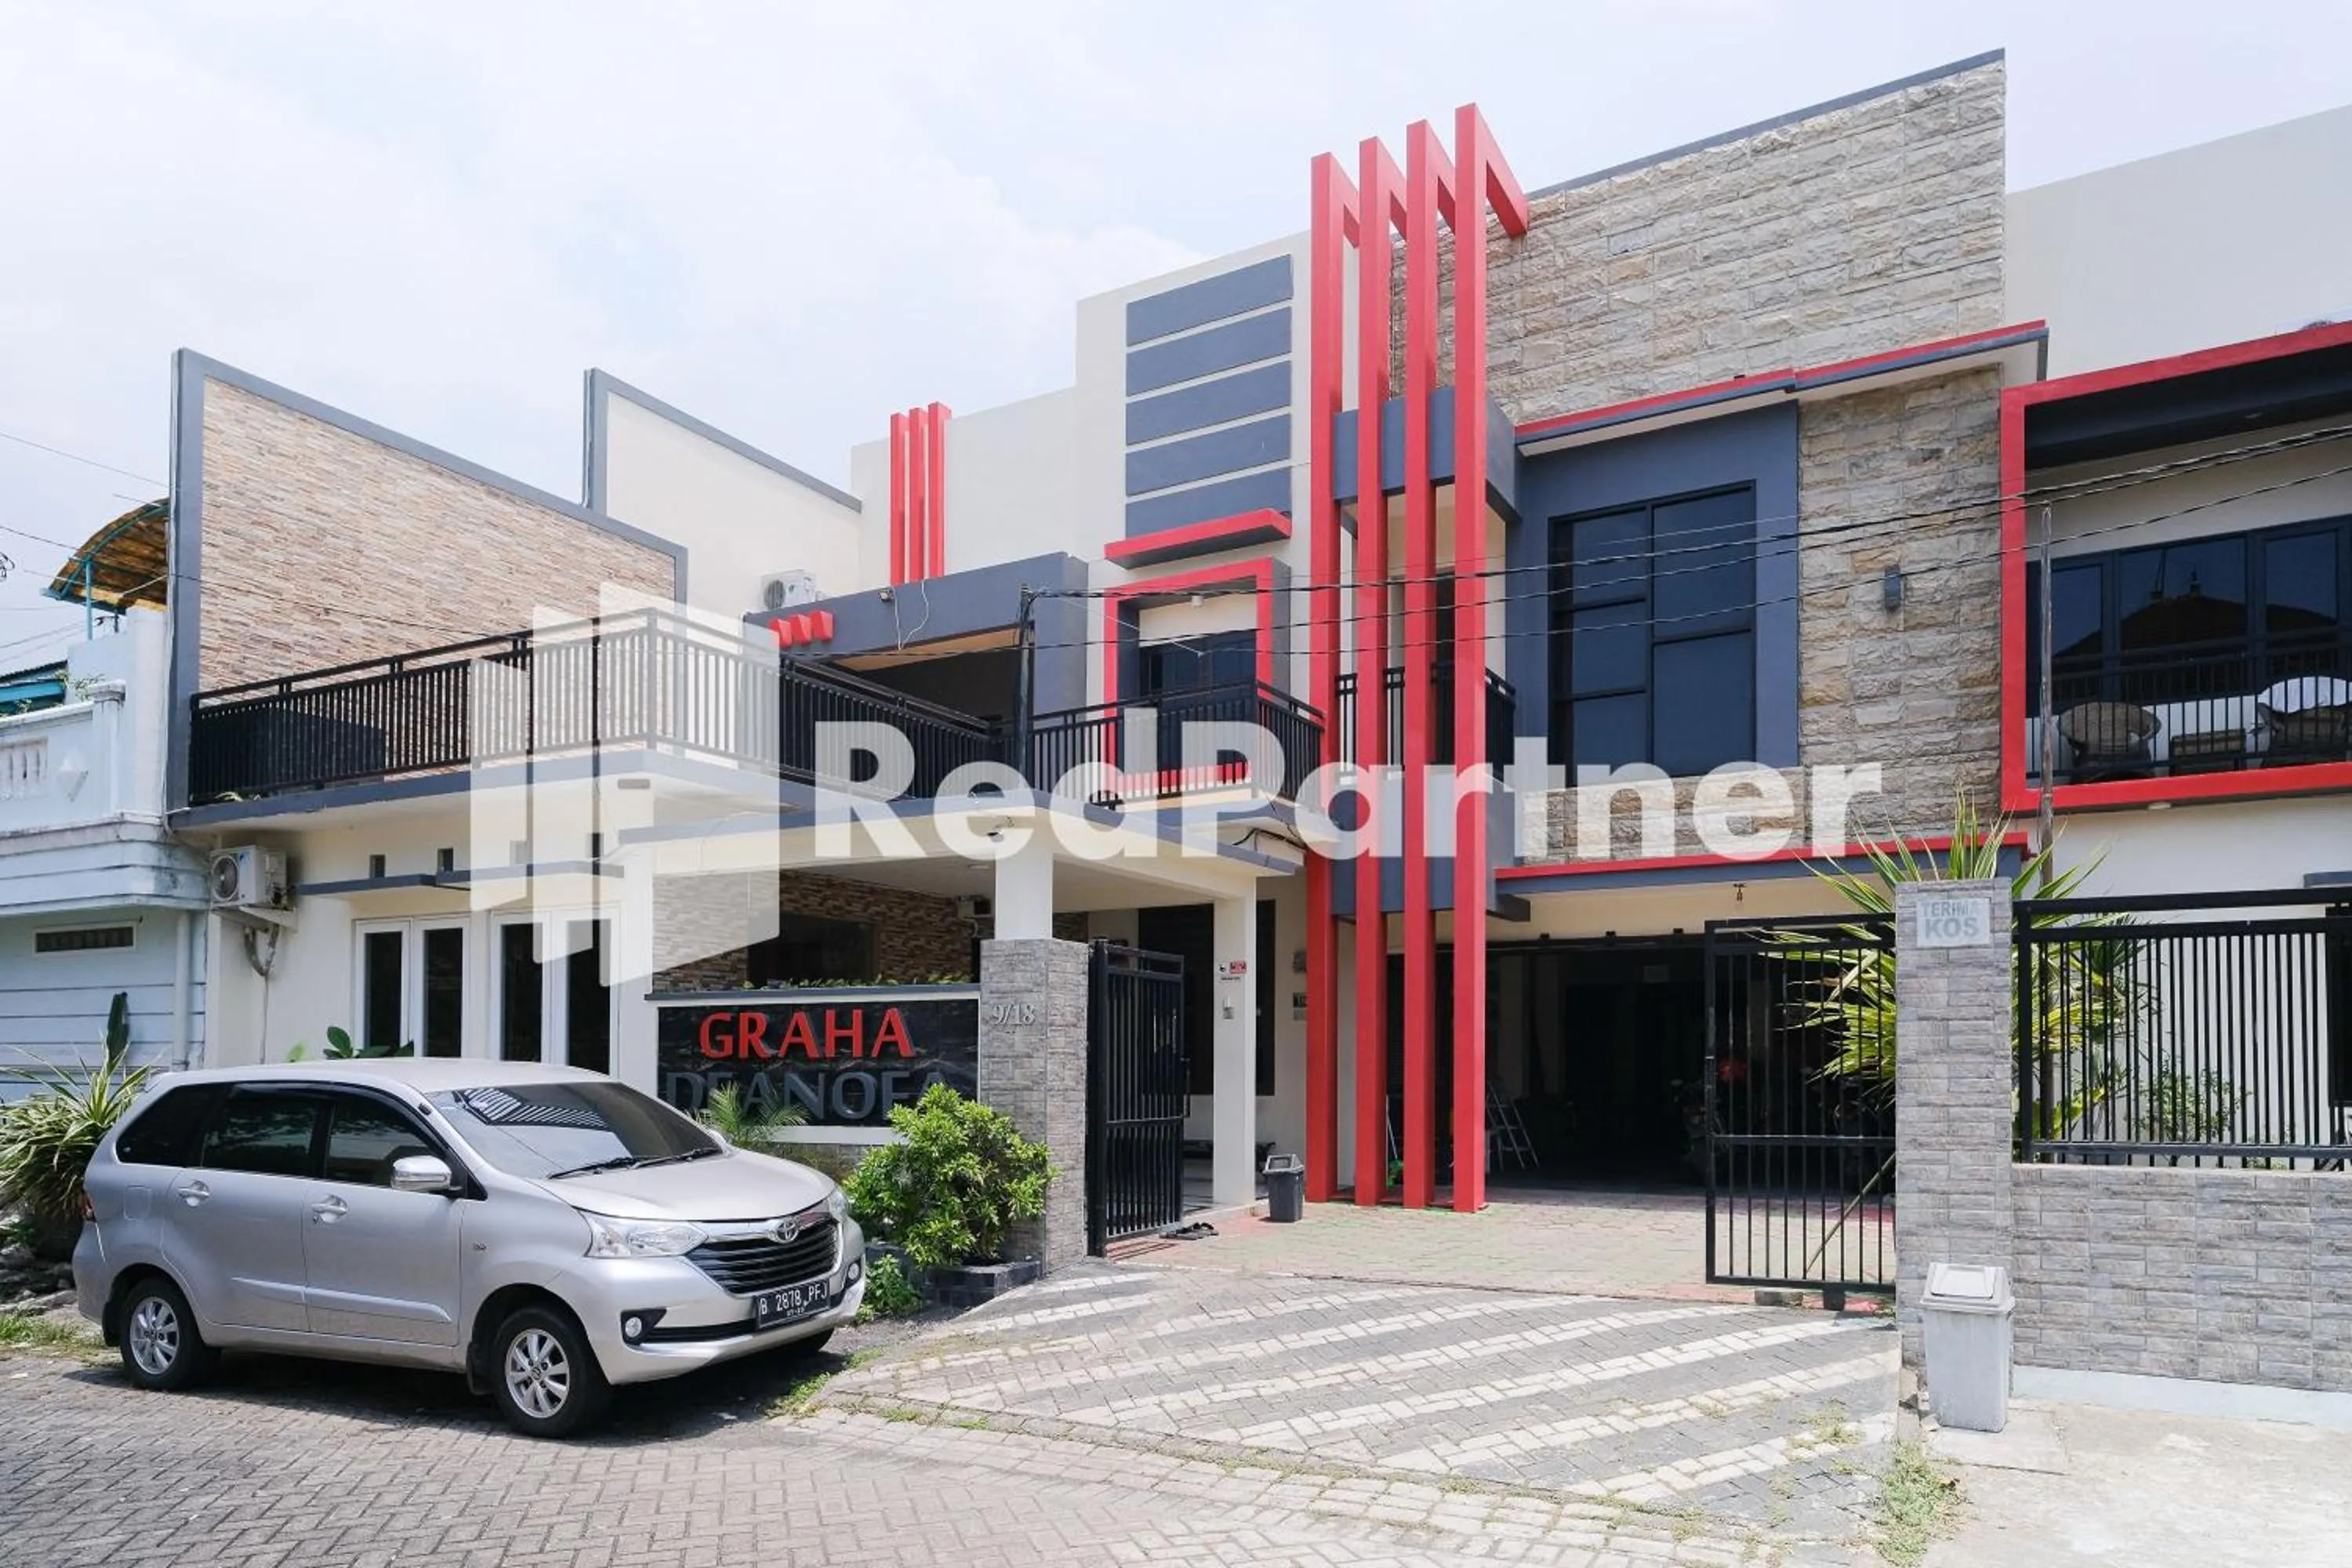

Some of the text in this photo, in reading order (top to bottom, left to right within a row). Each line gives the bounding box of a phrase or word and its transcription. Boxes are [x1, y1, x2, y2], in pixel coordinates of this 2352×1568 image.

[1925, 917, 1980, 939] KOS
[699, 1007, 915, 1059] GRAHA
[760, 1298, 768, 1315] B
[775, 1290, 801, 1312] 2878
[808, 1282, 828, 1302] PFJ
